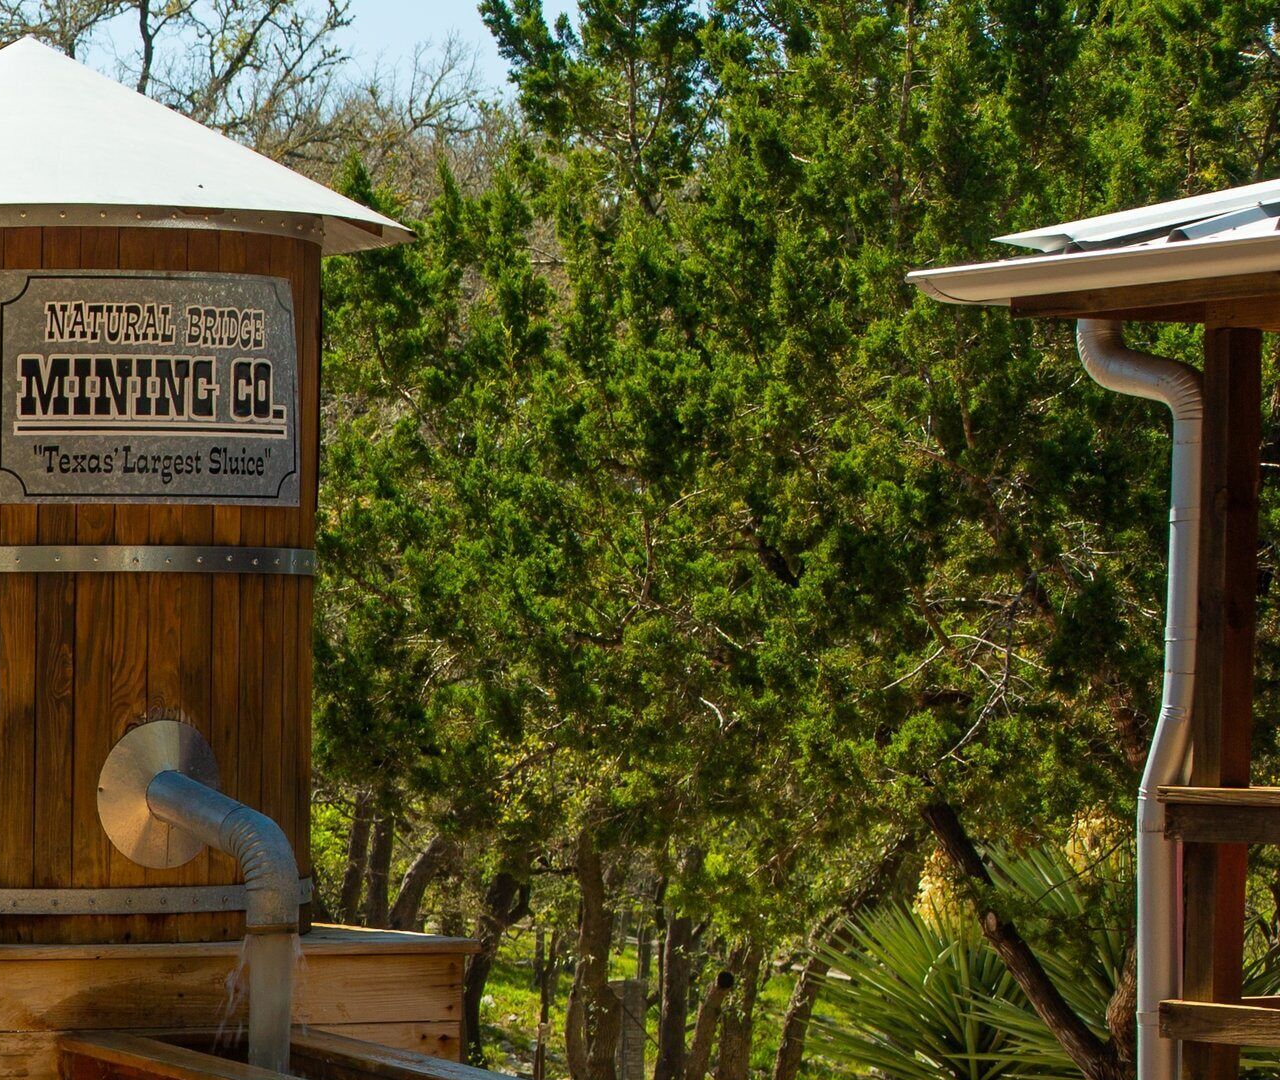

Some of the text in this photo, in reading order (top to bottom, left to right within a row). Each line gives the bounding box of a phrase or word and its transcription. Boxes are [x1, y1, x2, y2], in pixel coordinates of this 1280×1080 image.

[44, 300, 266, 351] NATURAL BRIDGE
[16, 354, 288, 424] MINING CO.
[33, 445, 272, 484] "Texas' Largest Sluice"
